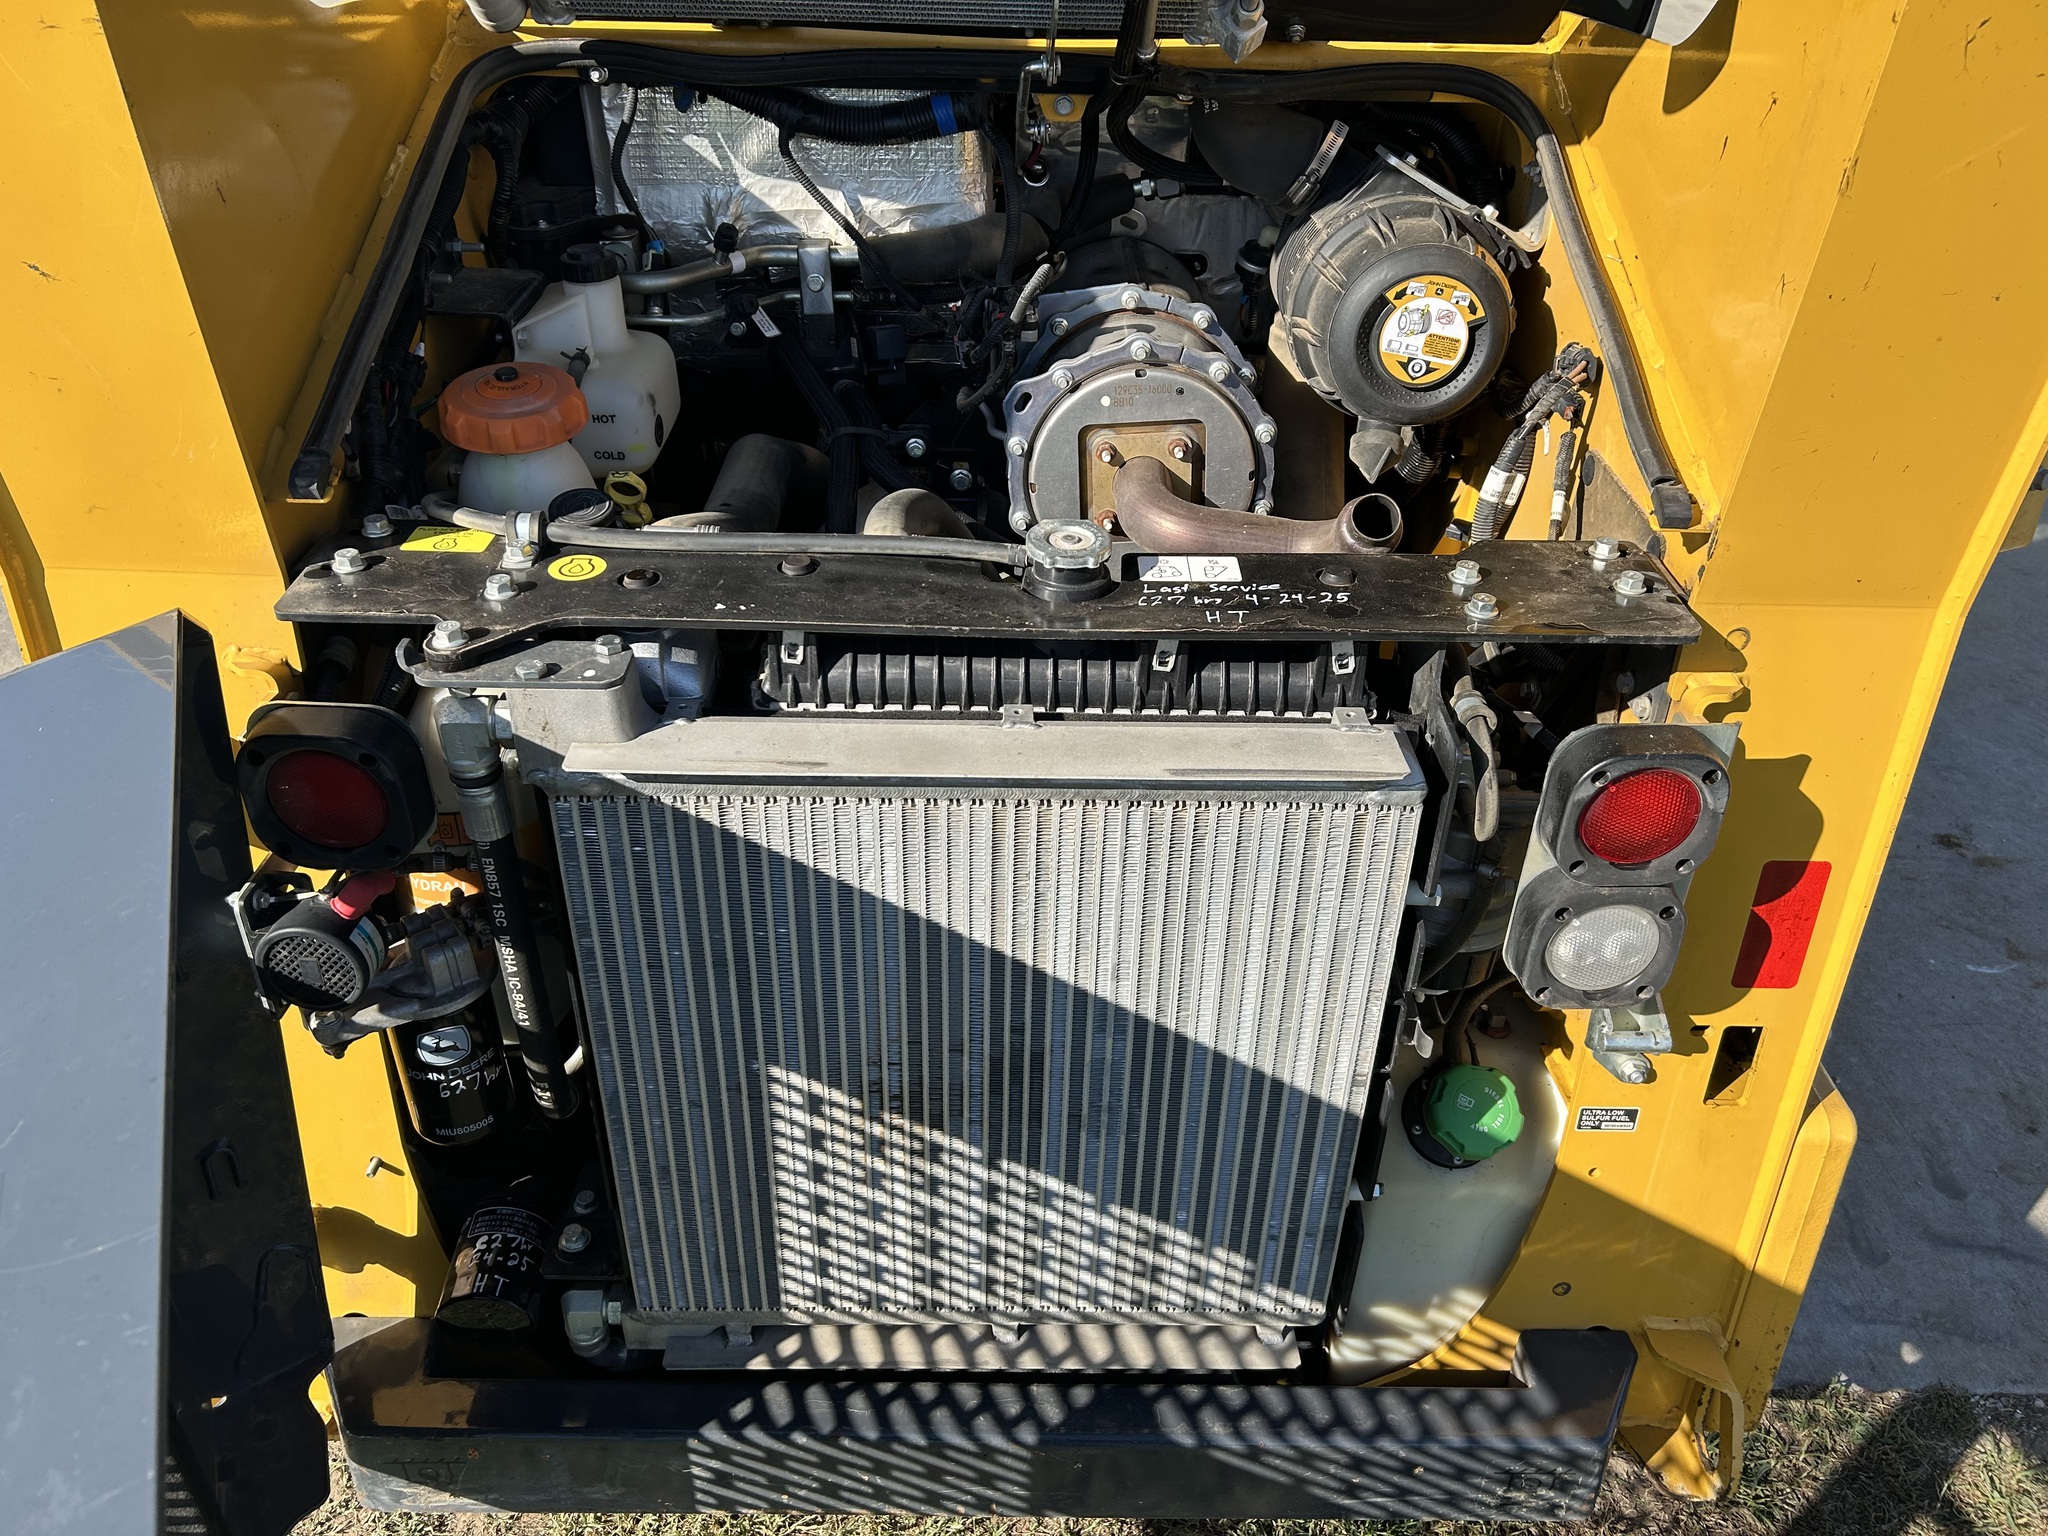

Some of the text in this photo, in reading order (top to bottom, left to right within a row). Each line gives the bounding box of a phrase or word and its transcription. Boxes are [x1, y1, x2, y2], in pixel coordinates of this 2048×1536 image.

[591, 414, 617, 424] HOT
[594, 450, 626, 461] COLD
[1143, 583, 1190, 594] Last
[481, 857, 502, 898] EN857
[492, 902, 508, 927] 1SC
[499, 934, 517, 974] MSHA
[408, 1047, 495, 1081] JOHN DEERE
[1484, 1086, 1504, 1109] DIESEL
[435, 1114, 494, 1137] MIU805005
